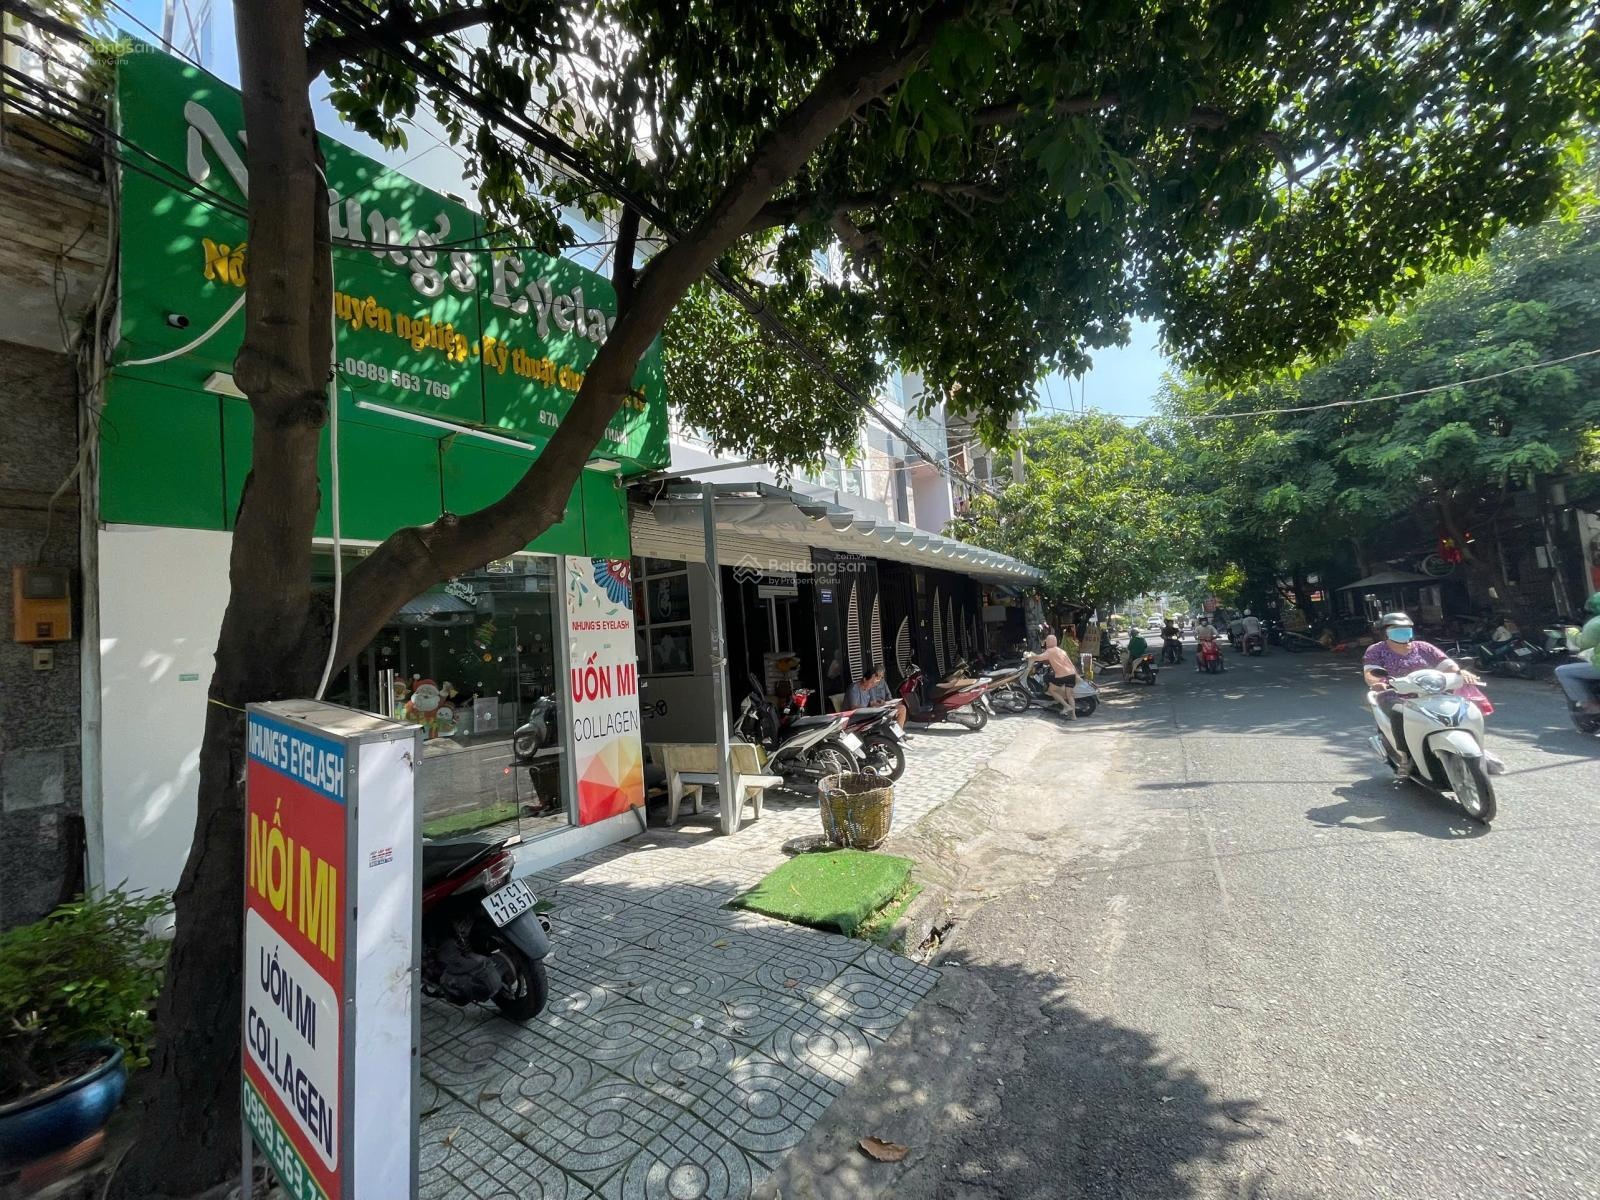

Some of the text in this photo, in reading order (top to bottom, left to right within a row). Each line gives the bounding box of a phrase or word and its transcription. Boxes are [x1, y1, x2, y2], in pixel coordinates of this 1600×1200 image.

[184, 100, 615, 344] Nung's Eyela
[202, 238, 247, 287] Nố
[334, 290, 393, 333] uyên
[396, 313, 468, 363] nghiệp
[512, 348, 557, 388] thuật
[345, 357, 451, 401] 0989 563 769
[539, 409, 559, 428] 97A
[571, 620, 630, 631] NHUNG'S EYELASH
[571, 651, 636, 703] UỐN MI
[574, 709, 638, 742] COLLAGEN
[249, 720, 344, 799] NHUNG'S EYELASH
[250, 796, 337, 963] NỐI MI
[490, 882, 522, 908] 47-C1
[495, 892, 533, 923] 178.57
[260, 944, 317, 1051] UỐN MI
[248, 1005, 333, 1159] COLLAGEN
